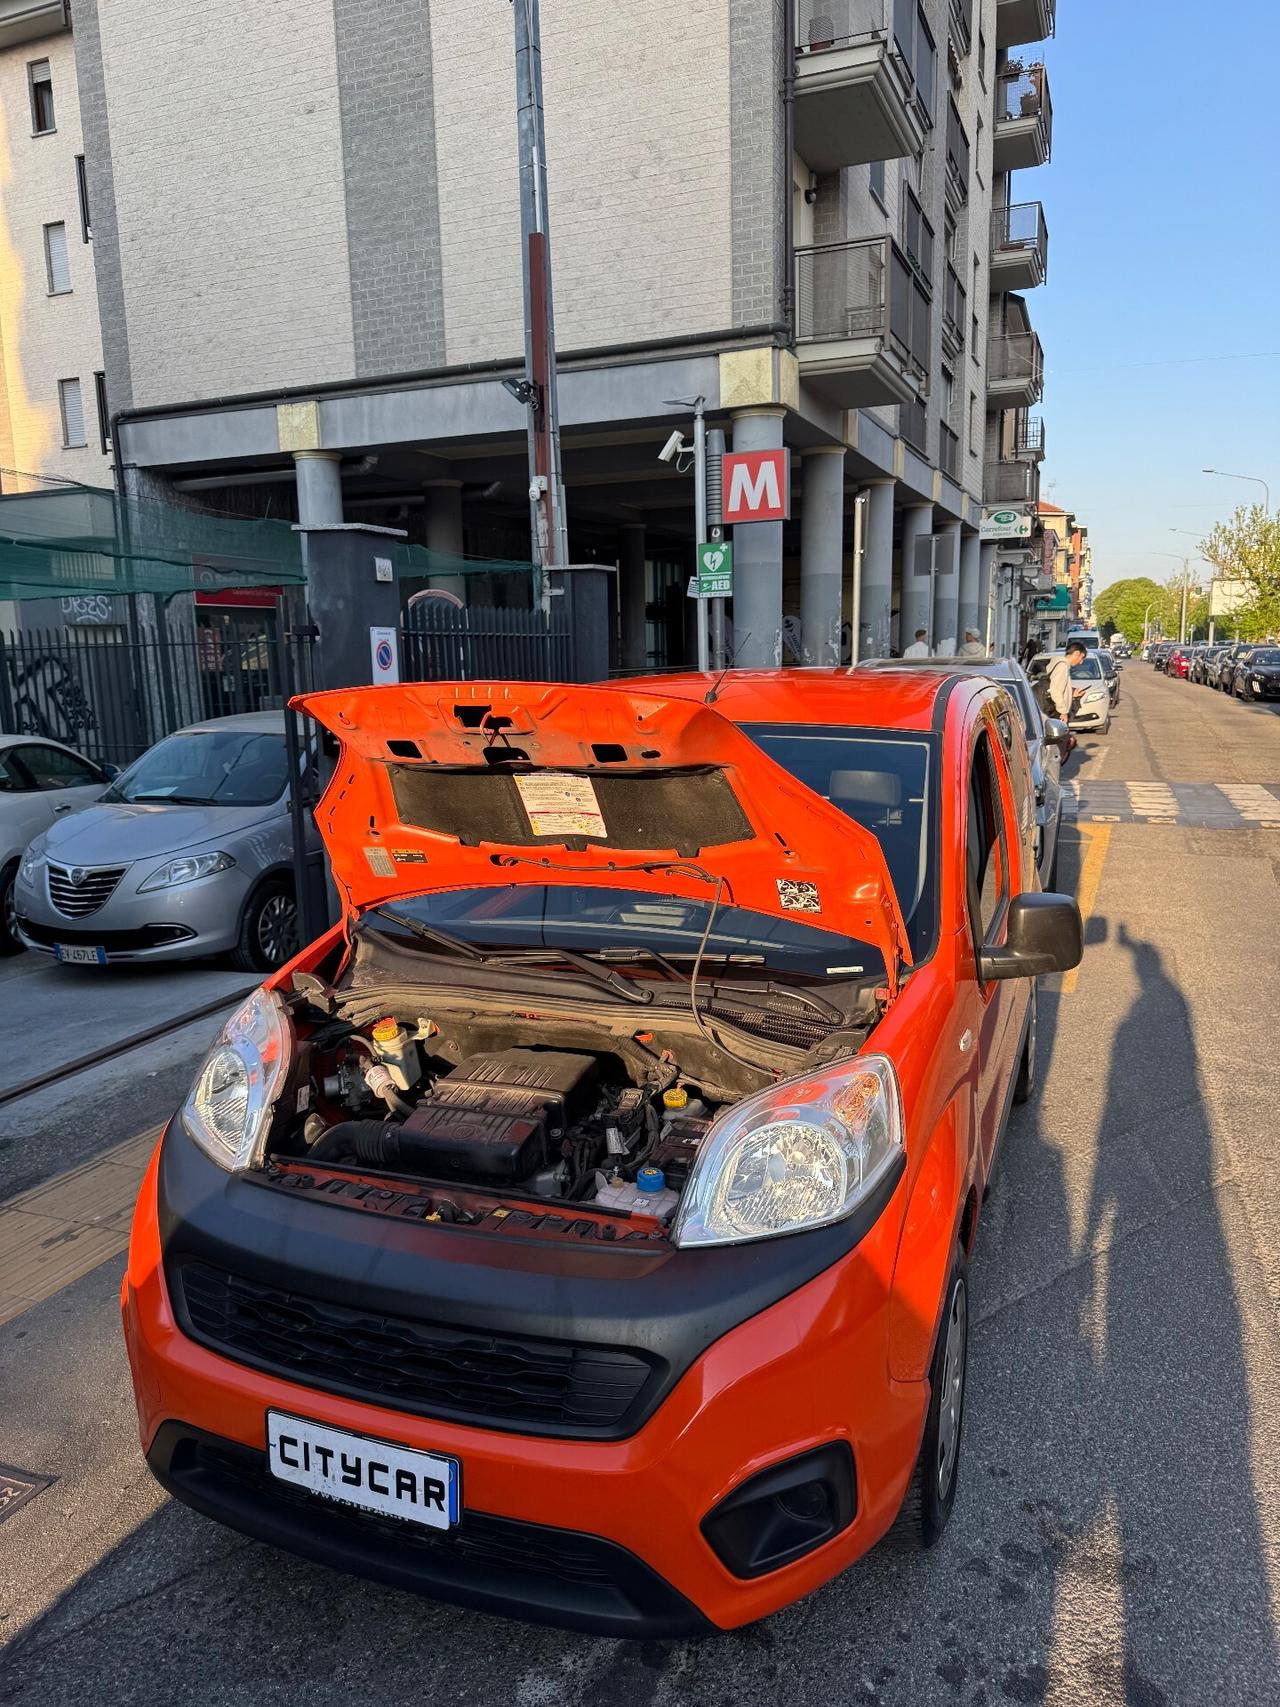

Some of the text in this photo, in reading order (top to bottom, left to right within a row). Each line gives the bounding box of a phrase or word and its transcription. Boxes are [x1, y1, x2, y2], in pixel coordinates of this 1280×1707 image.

[728, 460, 781, 512] M
[711, 580, 730, 590] AED
[279, 1434, 446, 1512] CITYCAR
